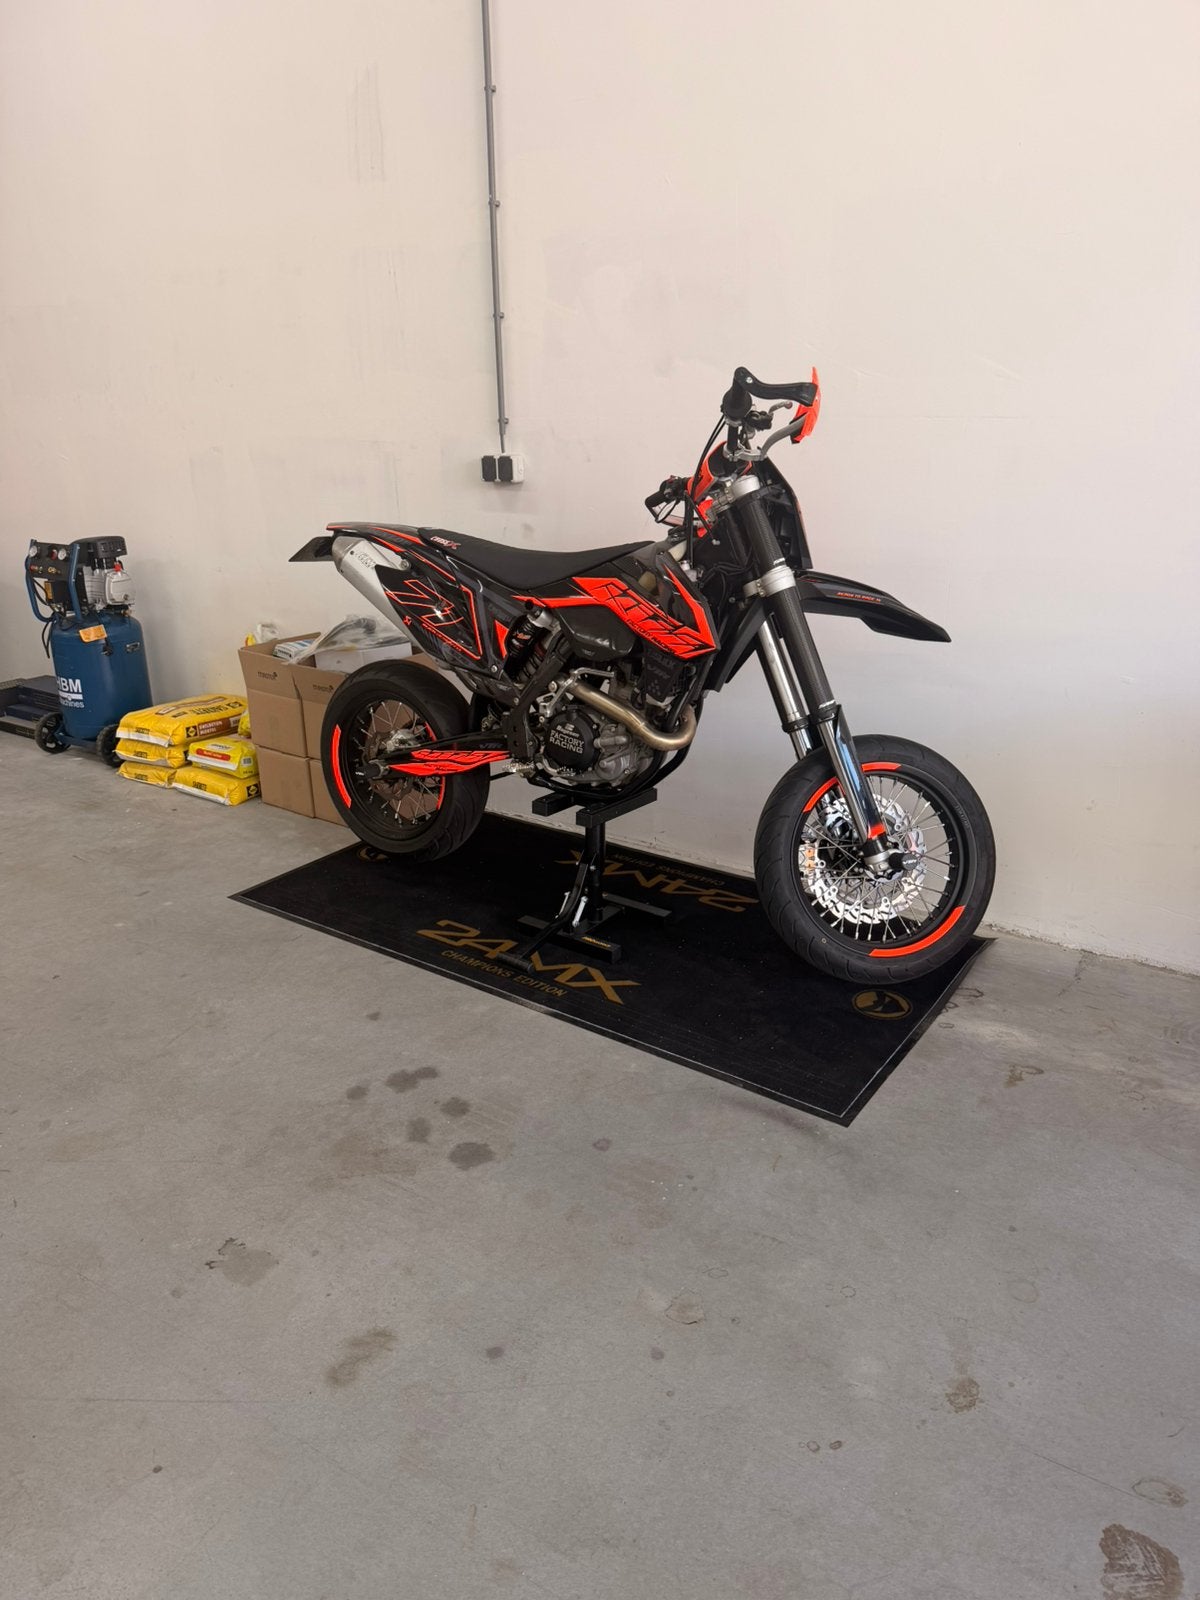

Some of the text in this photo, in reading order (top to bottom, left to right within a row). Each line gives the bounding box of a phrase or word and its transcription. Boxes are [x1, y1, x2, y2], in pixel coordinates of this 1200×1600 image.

[57, 677, 82, 693] HBM
[550, 730, 585, 748] FACTORY
[550, 737, 584, 754] RACING
[441, 950, 568, 997] CHAMPIONS EDITION
